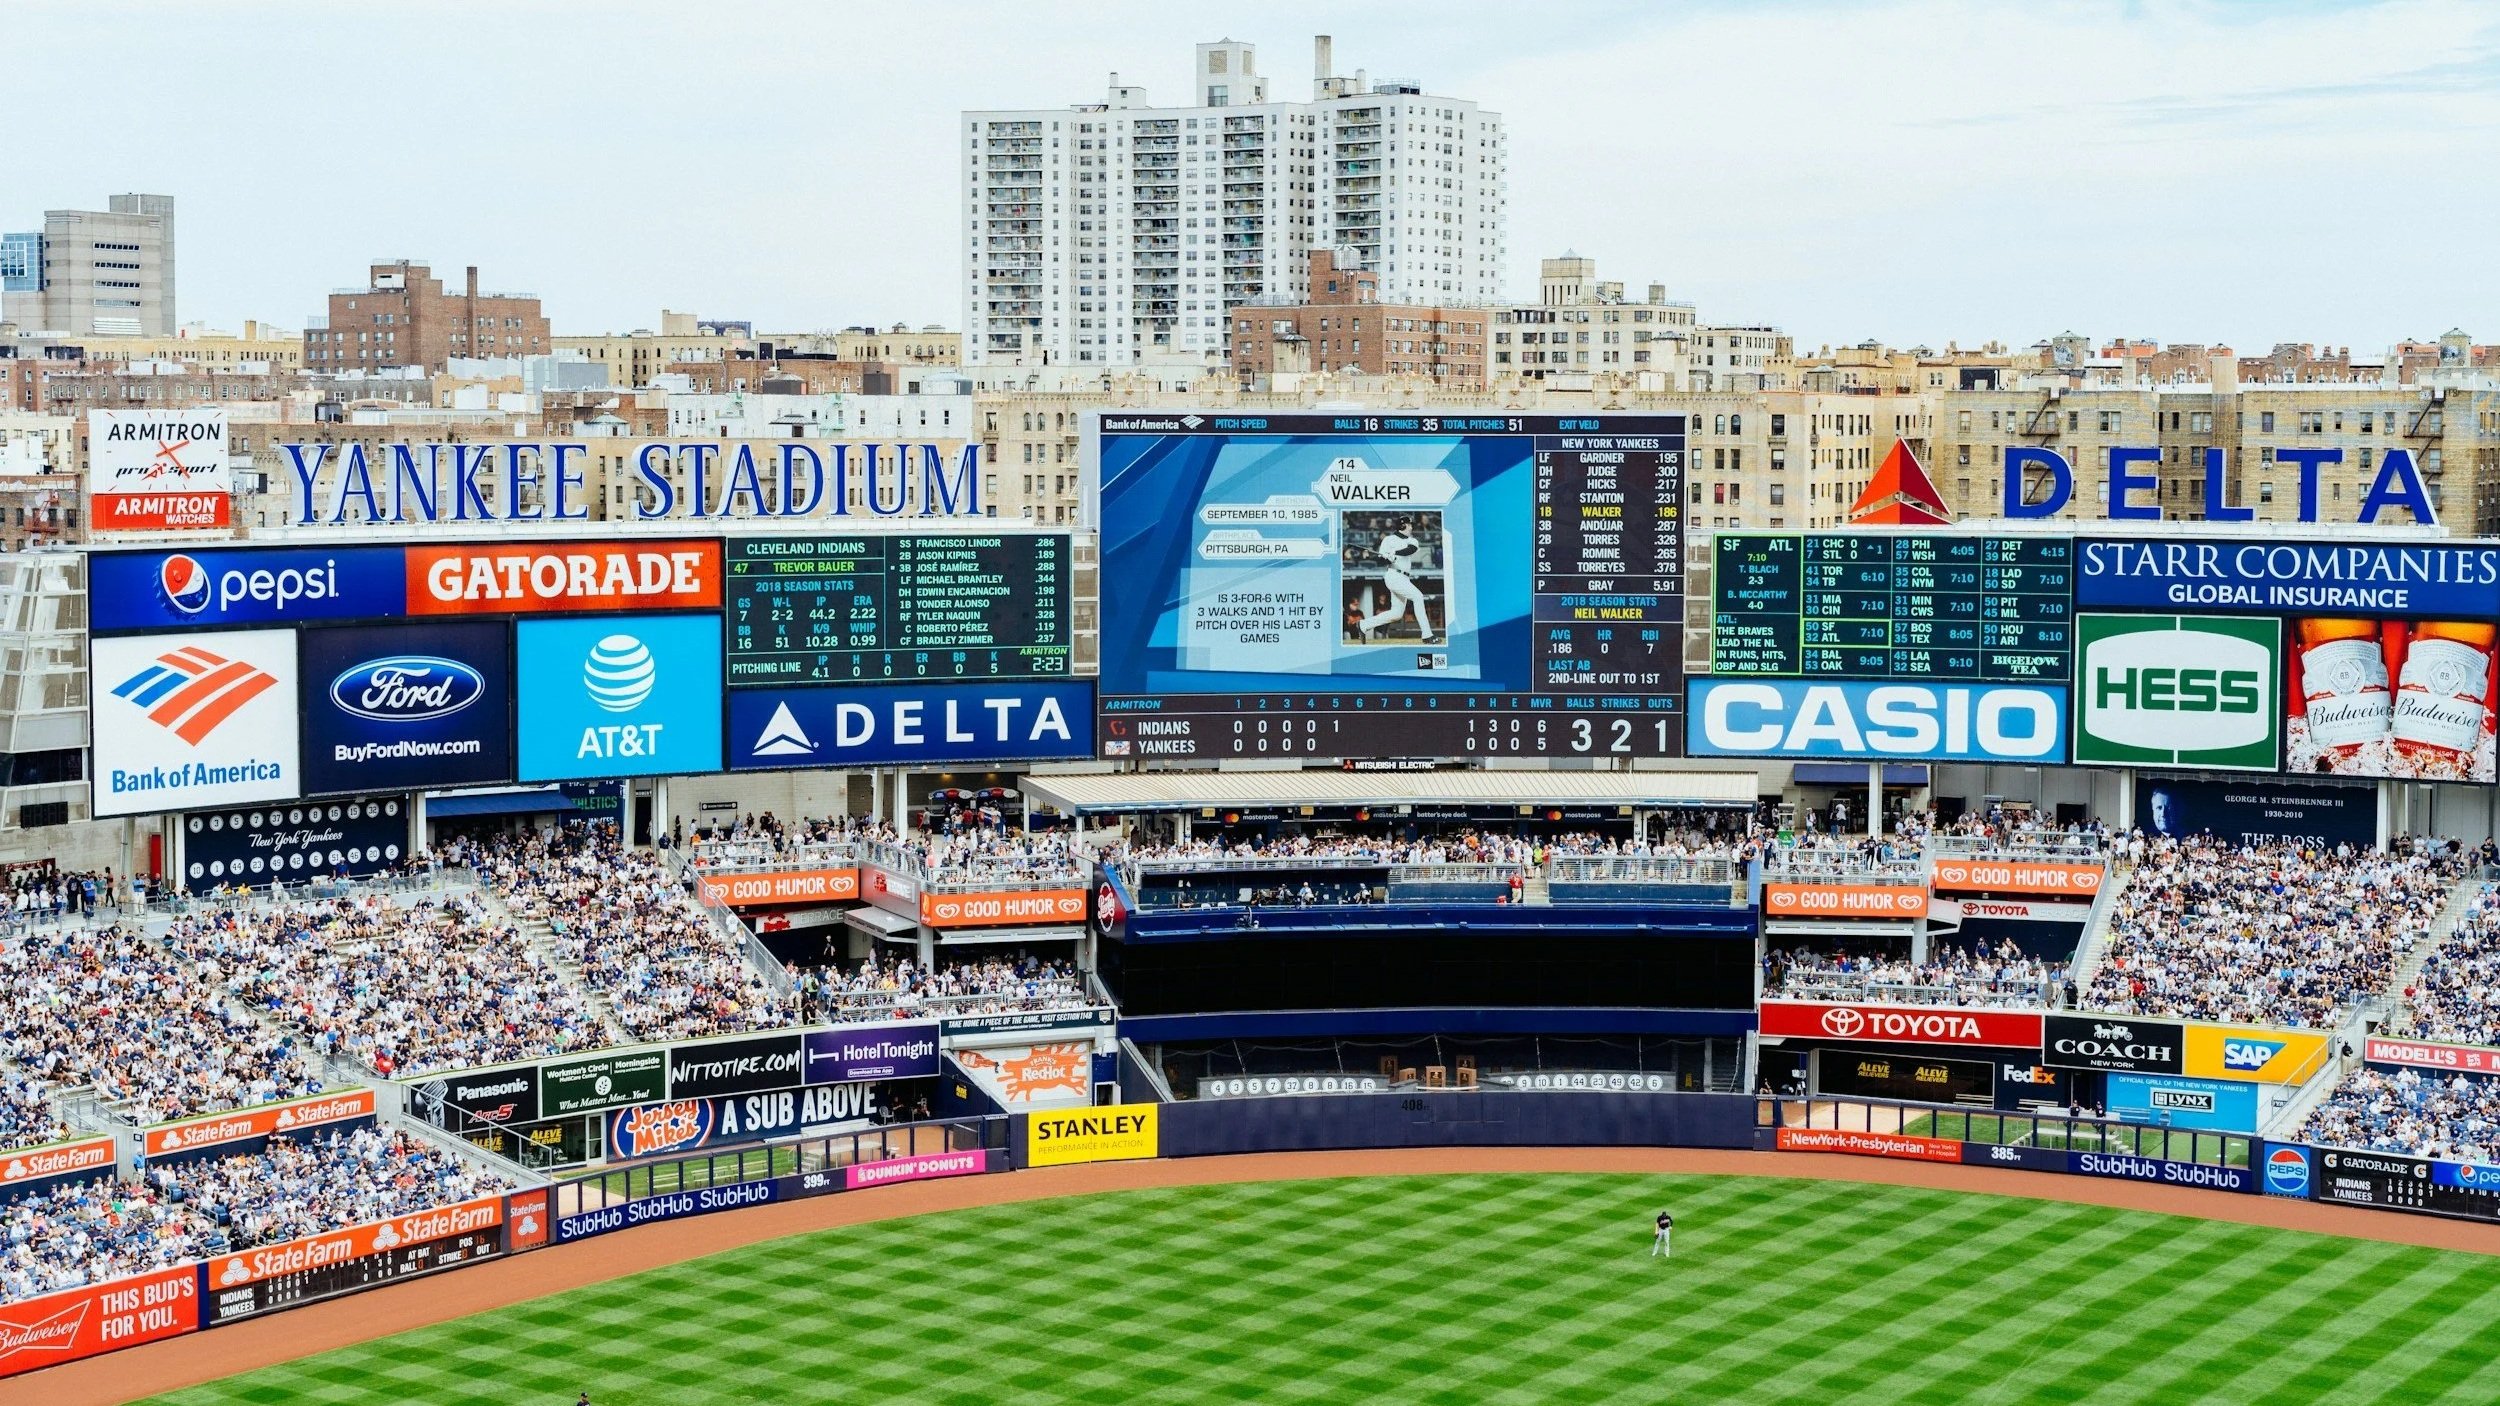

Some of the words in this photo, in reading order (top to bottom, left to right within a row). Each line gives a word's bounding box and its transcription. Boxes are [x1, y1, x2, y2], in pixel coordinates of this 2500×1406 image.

[107, 423, 220, 441] ARMITRON
[1106, 419, 1129, 430] Bank
[1130, 419, 1139, 430] of
[1140, 419, 1179, 430] America
[1334, 419, 1360, 430] BALLS
[1363, 418, 1378, 431] 16
[1384, 419, 1418, 430] STRIKES
[1423, 418, 1438, 431] 35
[1442, 419, 1467, 430] TOTAL
[1469, 419, 1504, 430] PITCHES
[1509, 418, 1523, 431] 51
[1562, 438, 1584, 448] NEW
[1587, 438, 1613, 448] YORK
[1616, 438, 1659, 448] YANKEES
[1338, 459, 1355, 470] 14
[280, 443, 589, 525] YANKEE
[638, 443, 983, 519] STADIUM
[1330, 474, 1352, 483] NEIL
[2005, 445, 2440, 525] DELTA
[1331, 485, 1410, 500] WALKER
[115, 497, 217, 515] ARMITRON
[1207, 510, 1268, 519] SEPTEMBER
[1292, 510, 1318, 519] 1985
[165, 513, 215, 525] WATCHES
[747, 543, 814, 555] CLEVELAND
[818, 542, 865, 553] INDIANS
[1275, 544, 1288, 553] PA
[734, 563, 748, 573] 47
[773, 562, 814, 573] TREVOR
[818, 562, 854, 572] BAUER
[2084, 543, 2228, 578] STARR
[2236, 546, 2497, 584] COMPANIES
[221, 560, 339, 611] pepsi
[427, 552, 703, 602] GATORADE
[1218, 593, 1228, 603] IS
[1231, 593, 1272, 603] 3-FOR-6
[1275, 593, 1304, 602] WITH
[2168, 584, 2263, 605] GLOBAL
[2269, 586, 2409, 608] INSURANCE
[1197, 607, 1205, 616] 3
[1207, 607, 1248, 616] WALKS
[1250, 607, 1275, 616] AND
[1278, 607, 1284, 616] 1
[1288, 606, 1307, 616] HIT
[1309, 606, 1323, 616] BY
[1196, 620, 1227, 630] PITCH
[1230, 620, 1259, 630] OVER
[1262, 620, 1281, 630] HIS
[1283, 620, 1310, 630] LAST
[1313, 620, 1321, 629] 3
[1716, 627, 1735, 636] THE
[1738, 627, 1773, 636] BRAVES
[1240, 633, 1280, 643] GAMES
[1716, 639, 1740, 647] LEAD
[1743, 639, 1762, 647] THE
[1764, 639, 1777, 647] NL
[1992, 656, 2059, 666] BIGELOW
[2011, 665, 2039, 675] TEA
[361, 666, 451, 710] Ford
[2097, 667, 2259, 714] HESS
[1567, 698, 1595, 708] BALLS
[1601, 698, 1640, 708] STRIKES
[1648, 698, 1673, 708] OUTS
[2398, 696, 2477, 728] Budweiser
[836, 697, 1071, 748] DELTA
[1705, 684, 2058, 755] CASIO
[2311, 702, 2390, 727] Budweiser
[1138, 721, 1190, 735] INDIANS
[1571, 719, 1592, 751] 3
[1611, 719, 1632, 752] 2
[1654, 719, 1667, 752] 1
[577, 724, 663, 759] AT&T
[1138, 740, 1196, 754] YANKEES
[334, 740, 480, 762] BuyFordNow.com
[1355, 761, 1396, 770] MITSUBISHI
[1399, 761, 1435, 769] ELECTRIC
[112, 764, 165, 793] Bank
[170, 763, 189, 788] of
[194, 759, 281, 786] America
[2224, 795, 2257, 804] GEORGE
[2271, 797, 2333, 807] STEINBRENNER
[2335, 799, 2344, 807] III
[2264, 810, 2303, 819] 1930-2010
[249, 833, 273, 848] New
[273, 832, 300, 852] York
[300, 828, 343, 849] Yankees
[1971, 867, 2010, 885] GOOD
[2014, 869, 2068, 888] HUMOR
[733, 879, 771, 898] GOOD
[775, 876, 826, 896] HUMOR
[964, 899, 1001, 918] GOOD
[1005, 897, 1054, 916] HUMOR
[1800, 891, 1838, 908] GOOD
[1842, 893, 1894, 910] HUMOR
[1981, 904, 2029, 917] TOYOTA
[1868, 1013, 1982, 1039] TOYOTA
[2055, 1038, 2172, 1062] COACH
[2225, 1043, 2273, 1066] SAP
[2374, 1044, 2457, 1065] MODELL'S
[587, 1063, 609, 1074] Circle
[615, 1056, 660, 1069] Morningside
[672, 1055, 800, 1084] NITTOTIRE.COM
[2090, 1060, 2110, 1068] NEW
[2112, 1061, 2134, 1069] YORK
[2003, 1064, 2055, 1084] FedEx
[457, 1078, 529, 1101] Panasonic
[559, 1100, 578, 1110] What
[721, 1100, 739, 1136] A
[745, 1093, 794, 1131] SUB
[801, 1081, 878, 1124] ABOVE
[2169, 1093, 2208, 1108] LYNX
[627, 1098, 699, 1131] Jersey
[1038, 1115, 1146, 1140] STANLEY
[634, 1119, 700, 1156] Mike's
[1100, 1141, 1109, 1150] IN
[1111, 1139, 1143, 1149] ACTION
[866, 1162, 918, 1181] DUNKIN'
[920, 1156, 974, 1173] DONUTS
[2080, 1154, 2157, 1178] StubHub
[2164, 1165, 2240, 1188] StubHub
[2269, 1164, 2307, 1177] PEPSI
[2343, 1157, 2408, 1174] GATORADE
[2336, 1178, 2371, 1190] INDIANS
[2334, 1188, 2372, 1201] YANKEES
[561, 1206, 622, 1237] StubHub
[628, 1194, 693, 1222] StubHub
[700, 1184, 768, 1209] StubHub
[100, 1288, 139, 1316] THIS
[144, 1275, 194, 1306] BUD'S
[220, 1288, 253, 1305] INDIANS
[219, 1300, 255, 1318] YANKEES
[101, 1317, 134, 1341] FOR
[138, 1306, 177, 1332] YOU.
